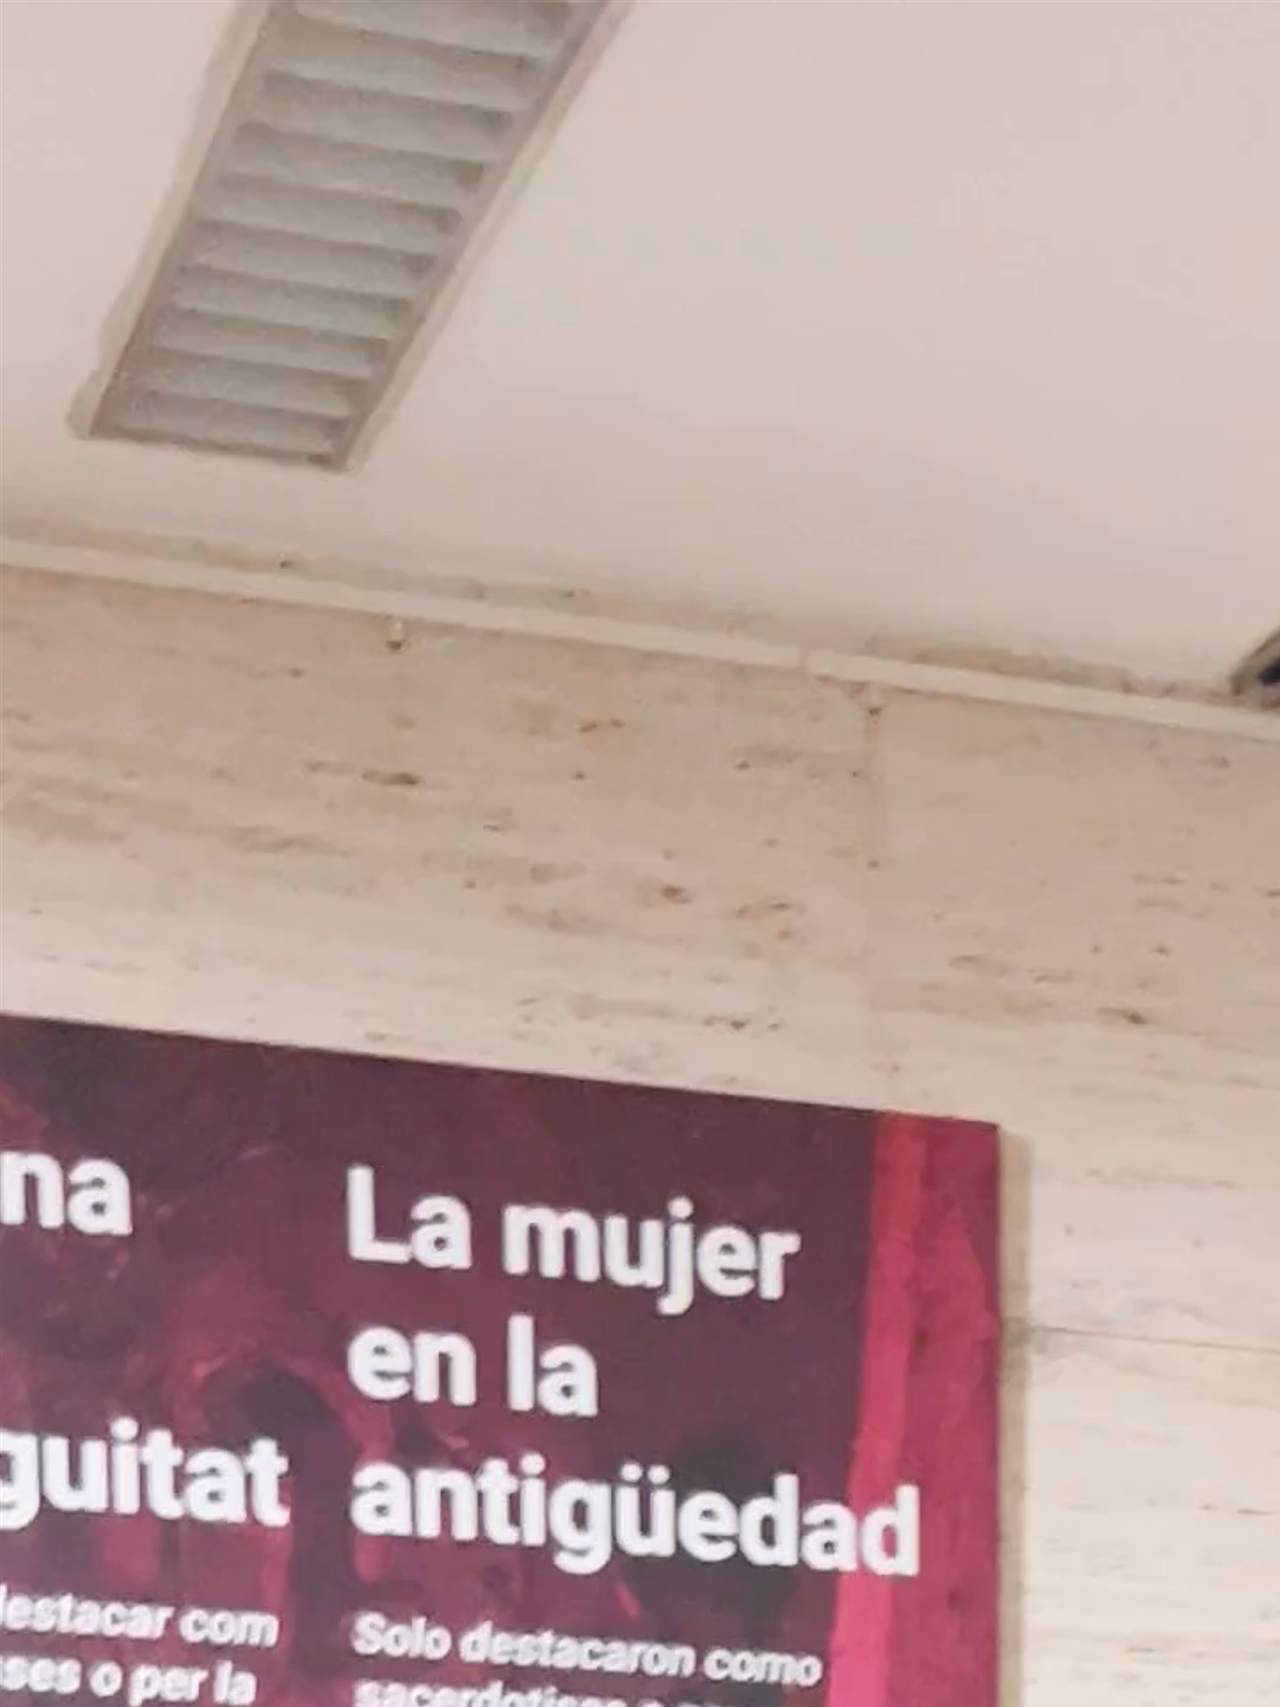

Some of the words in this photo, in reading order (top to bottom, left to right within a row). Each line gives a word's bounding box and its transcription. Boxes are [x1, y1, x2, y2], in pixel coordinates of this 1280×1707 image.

[0, 1151, 133, 1236] na
[346, 1164, 472, 1270] La
[503, 1196, 801, 1315] mujer
[346, 1324, 477, 1406] en
[507, 1313, 598, 1415] la
[0, 1416, 291, 1531] guitat
[349, 1452, 921, 1579] antigüedad
[179, 1607, 280, 1648] com
[352, 1611, 452, 1661] Solo
[459, 1619, 697, 1680] destacaron
[703, 1645, 824, 1687] como
[90, 1660, 123, 1698] o
[128, 1664, 208, 1707] per
[213, 1658, 258, 1706] la
